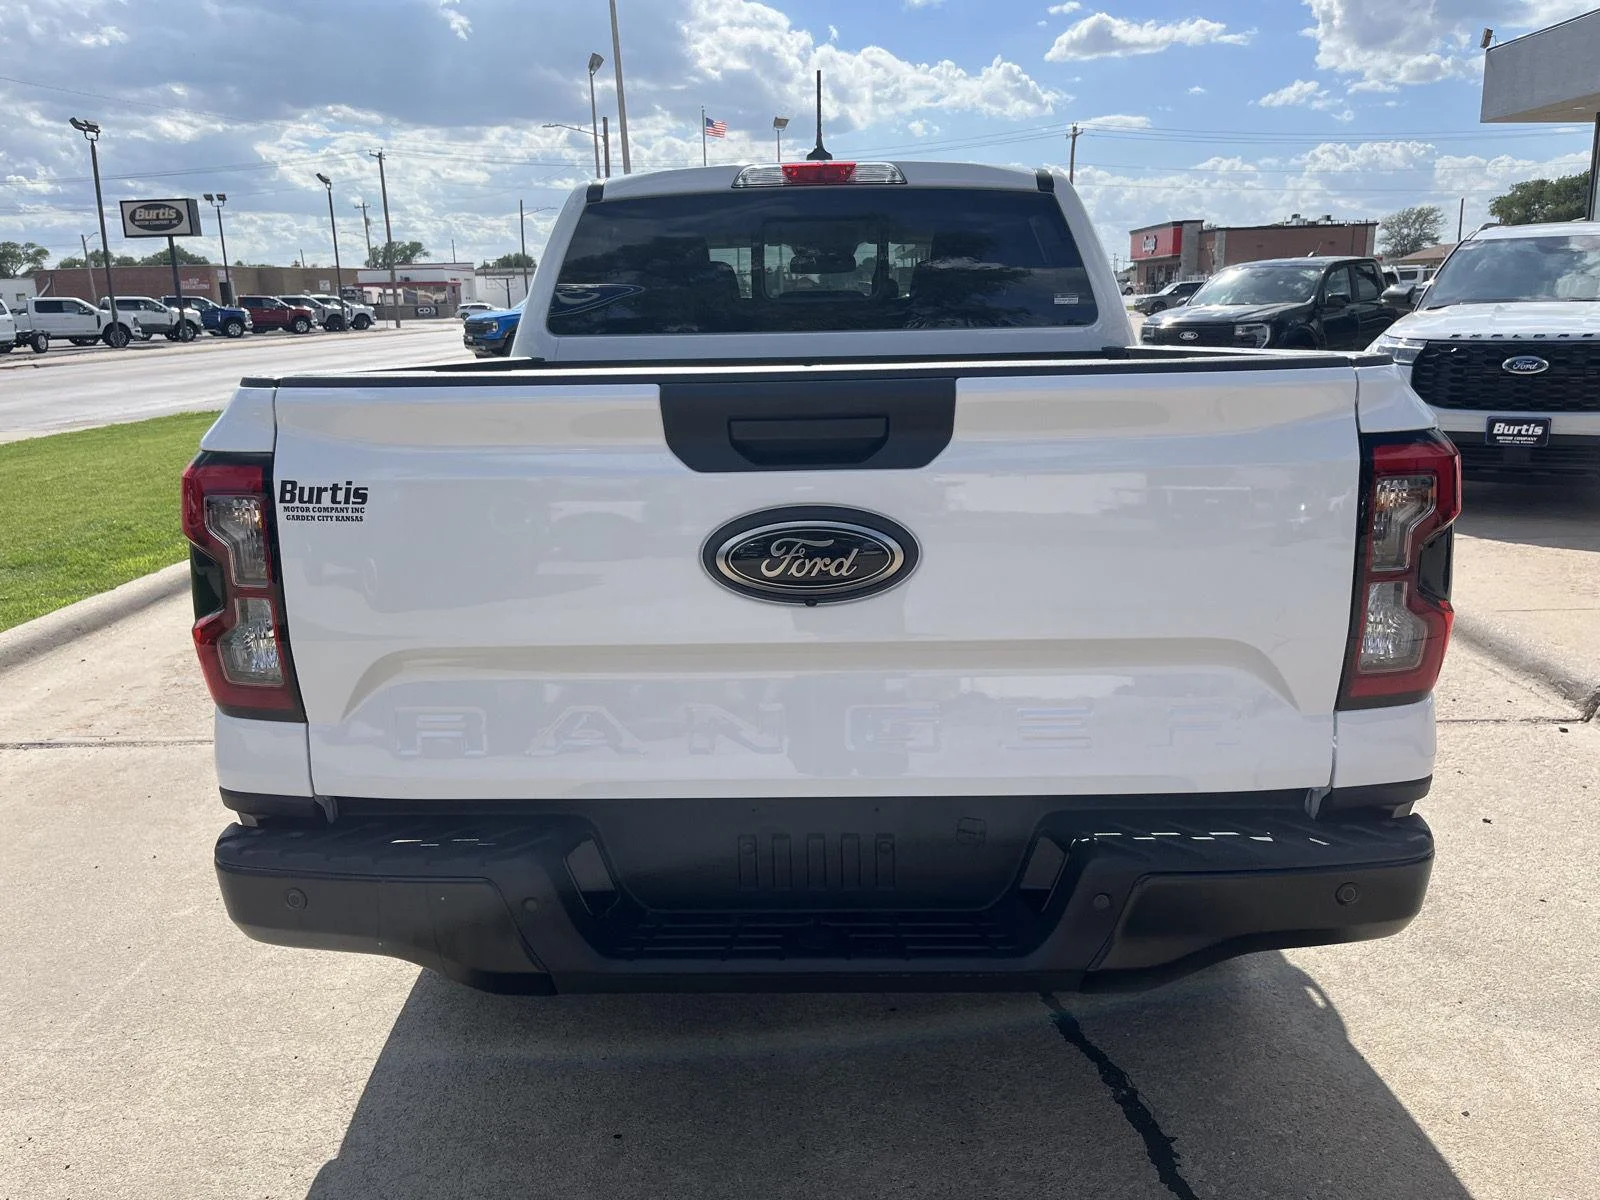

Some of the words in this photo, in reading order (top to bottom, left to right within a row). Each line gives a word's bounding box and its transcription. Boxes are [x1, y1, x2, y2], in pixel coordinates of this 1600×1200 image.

[135, 208, 177, 220] Burtis
[1512, 360, 1538, 370] Ford
[1493, 422, 1544, 435] Burtis
[278, 480, 369, 505] Burtis
[312, 506, 350, 514] COMPANY
[760, 537, 860, 578] Ford
